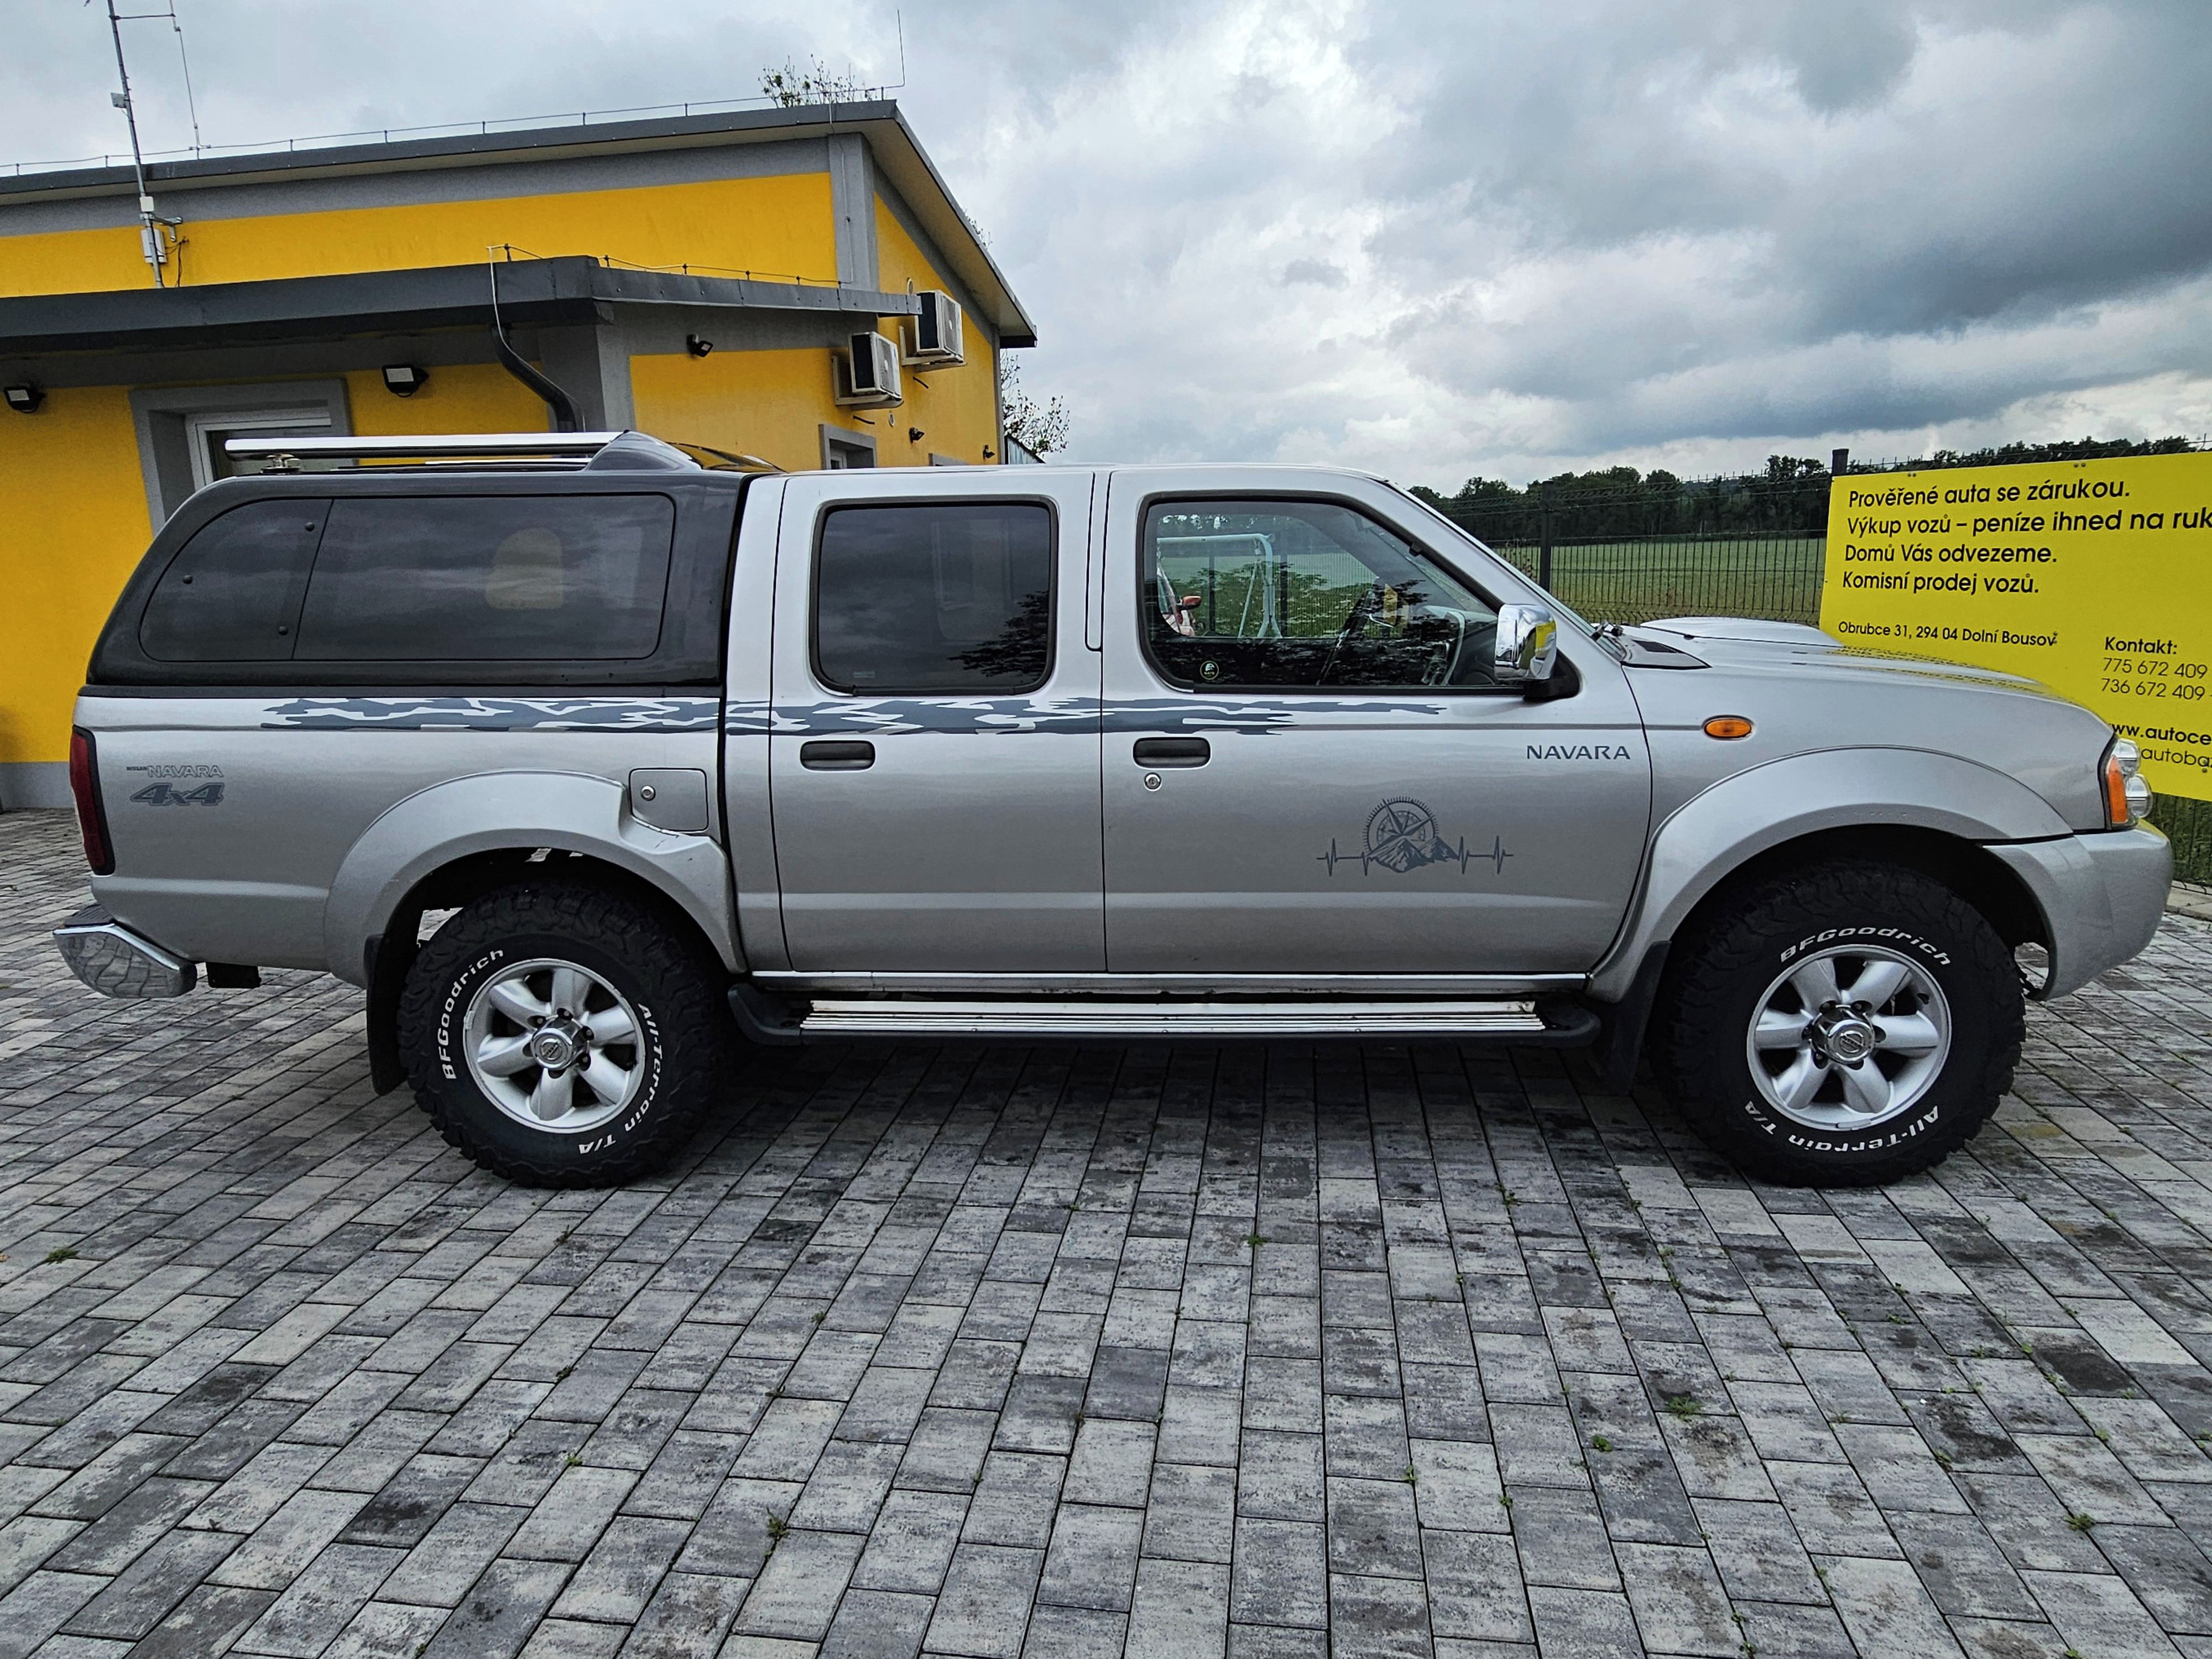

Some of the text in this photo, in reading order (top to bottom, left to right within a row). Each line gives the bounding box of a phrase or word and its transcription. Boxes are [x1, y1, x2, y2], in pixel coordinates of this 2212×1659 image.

[1849, 478, 2130, 508] Prověřené auta se zárukou.
[1847, 516, 1902, 538] Výkup
[1907, 514, 1951, 533] vozů
[1973, 512, 2045, 537] peníze
[2053, 509, 2123, 531] ihned
[2130, 512, 2164, 529] na
[2172, 507, 2212, 529] ruk
[1845, 543, 2057, 563] Domů Vás odvezeme.
[1843, 571, 2039, 596] Komisní prodej vozů.
[1838, 620, 2057, 646] Obrubce 31, 294 04 Dolní Bousov
[2105, 637, 2177, 655] Kontakt:
[2103, 657, 2208, 679] 775 672 409
[2101, 678, 2205, 701] 736 672 409
[2109, 723, 2212, 745] ww.autoce
[1526, 744, 1631, 760] NAVARA
[147, 765, 224, 778] NAVARA
[130, 782, 225, 806] 4x4
[1780, 926, 1952, 966] BFGoodrich
[437, 948, 504, 1080] BFGoodrich
[578, 1003, 663, 1155] All-Terrain T/A
[1744, 1099, 1940, 1152] All-Terrain T/A
